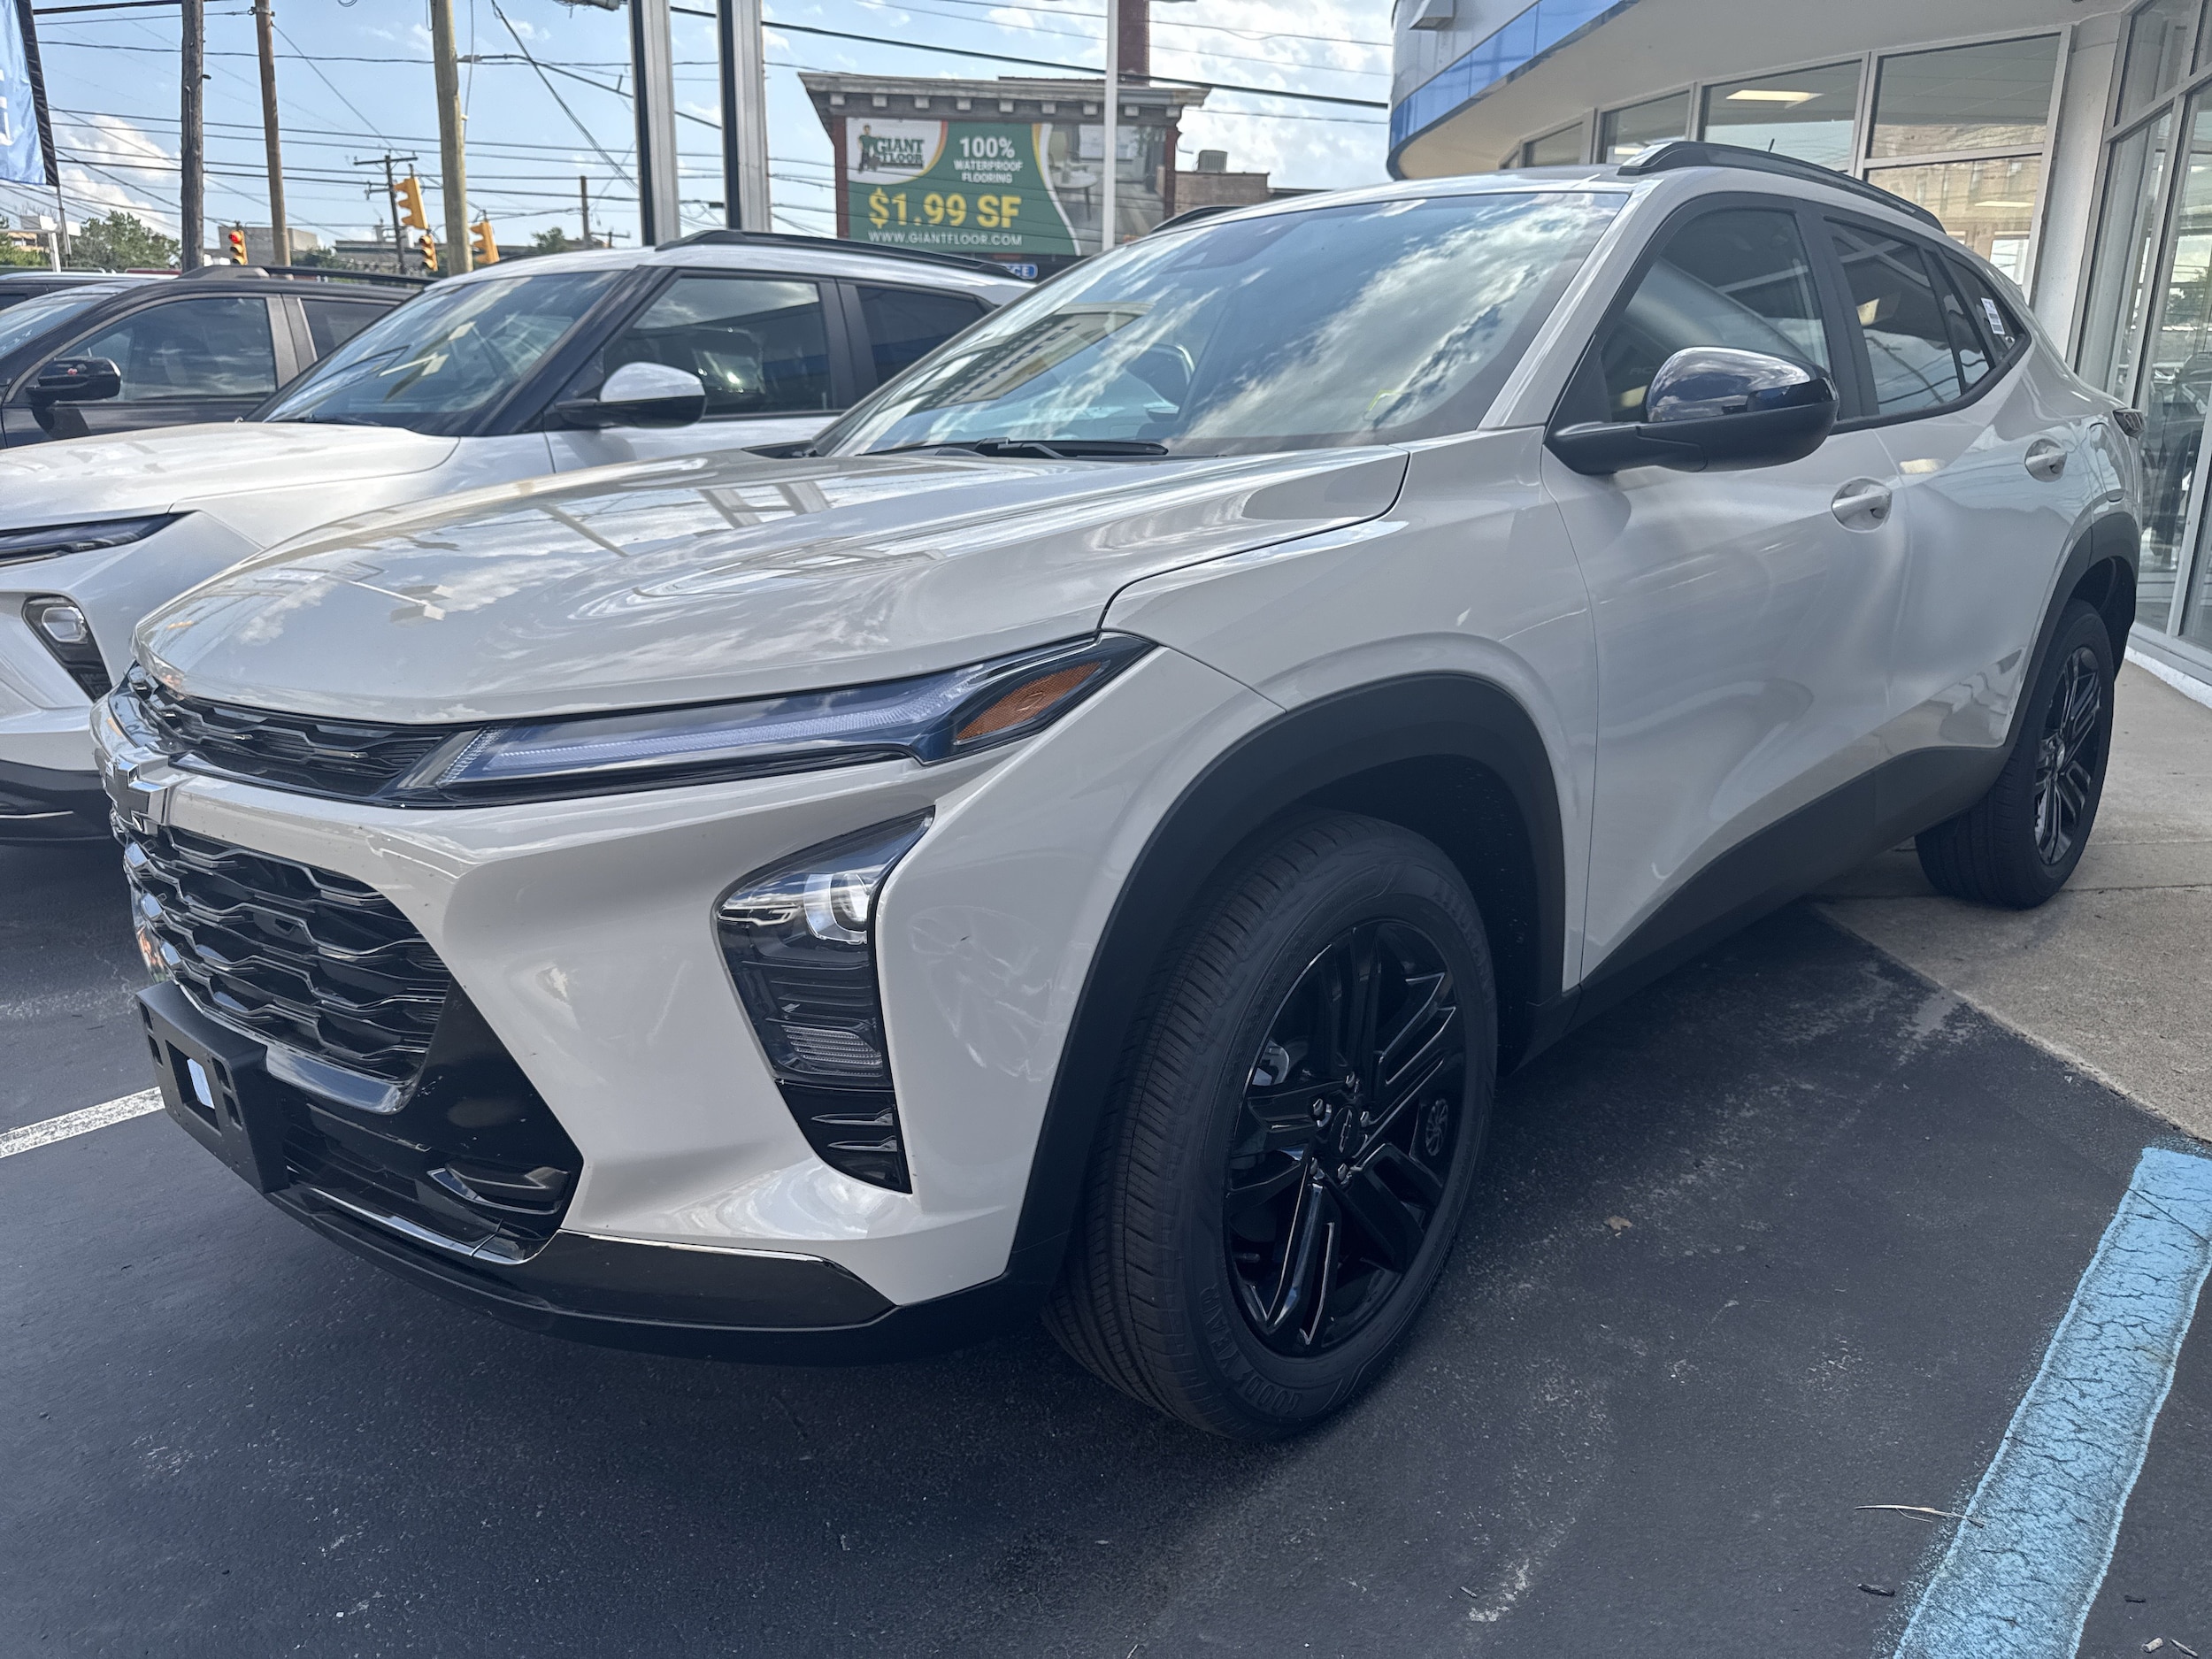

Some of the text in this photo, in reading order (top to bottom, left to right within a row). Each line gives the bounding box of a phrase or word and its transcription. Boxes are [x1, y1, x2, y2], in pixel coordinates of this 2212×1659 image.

[874, 137, 925, 154] GIANT
[959, 136, 1015, 158] 100%
[882, 153, 923, 164] FLOOR
[953, 159, 1023, 172] WATERPROOF
[961, 172, 1013, 184] FLOORING
[868, 187, 1022, 229] $1.99 SF
[867, 230, 1023, 246] WWW.GIANTFLOOR.COM
